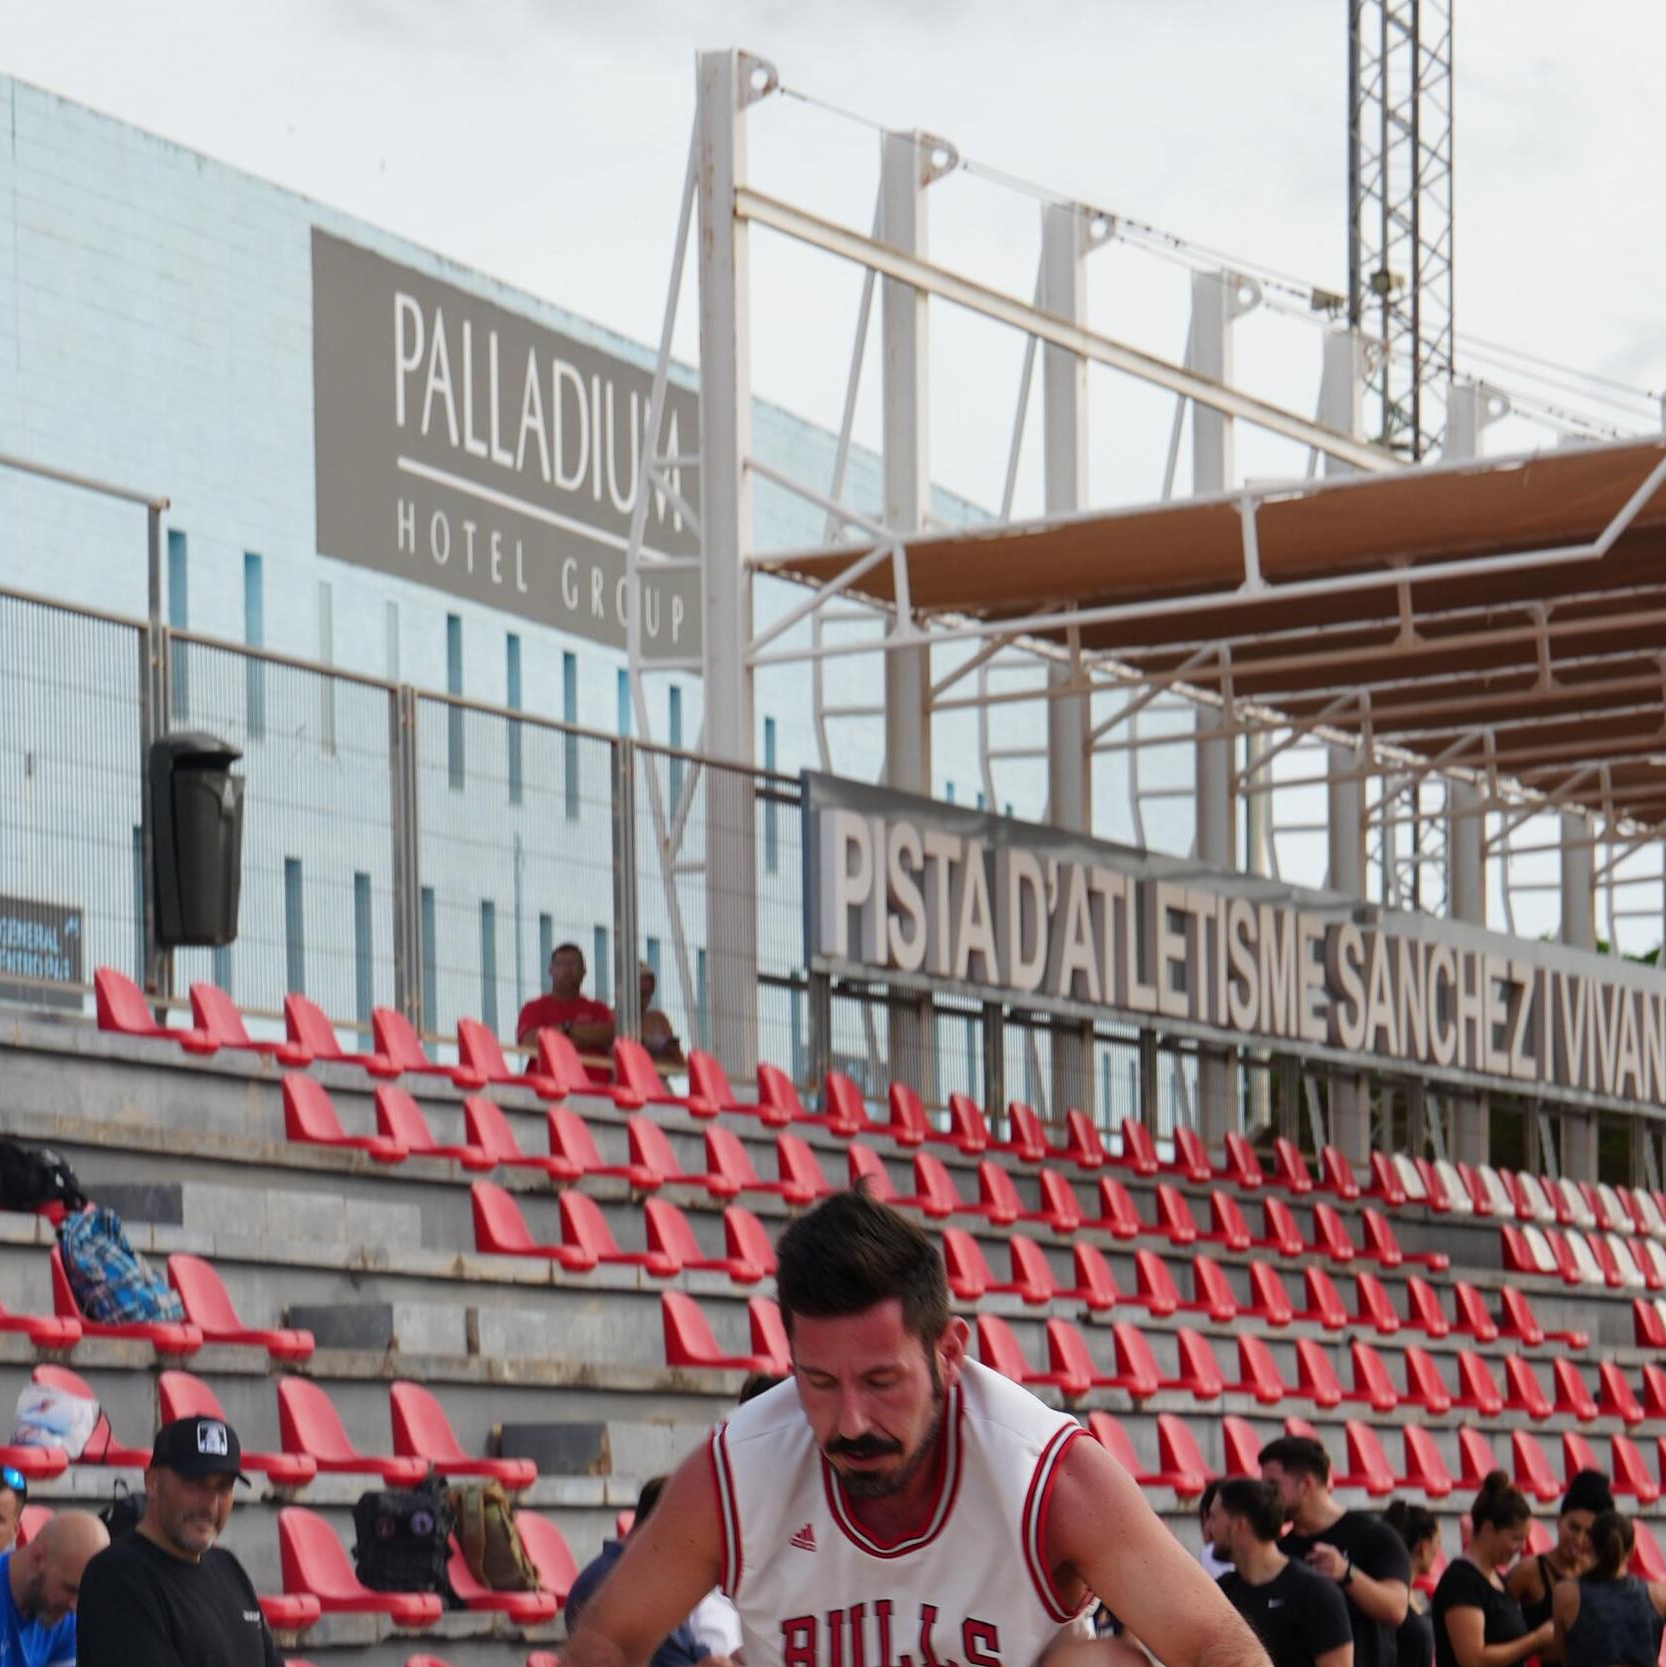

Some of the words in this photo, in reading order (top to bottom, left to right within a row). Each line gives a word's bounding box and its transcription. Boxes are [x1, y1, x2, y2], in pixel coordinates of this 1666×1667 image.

[395, 291, 682, 533] PALLADIUM
[397, 499, 528, 593] HOTEL
[562, 557, 684, 643] GROUP
[827, 808, 1000, 986] PISTA
